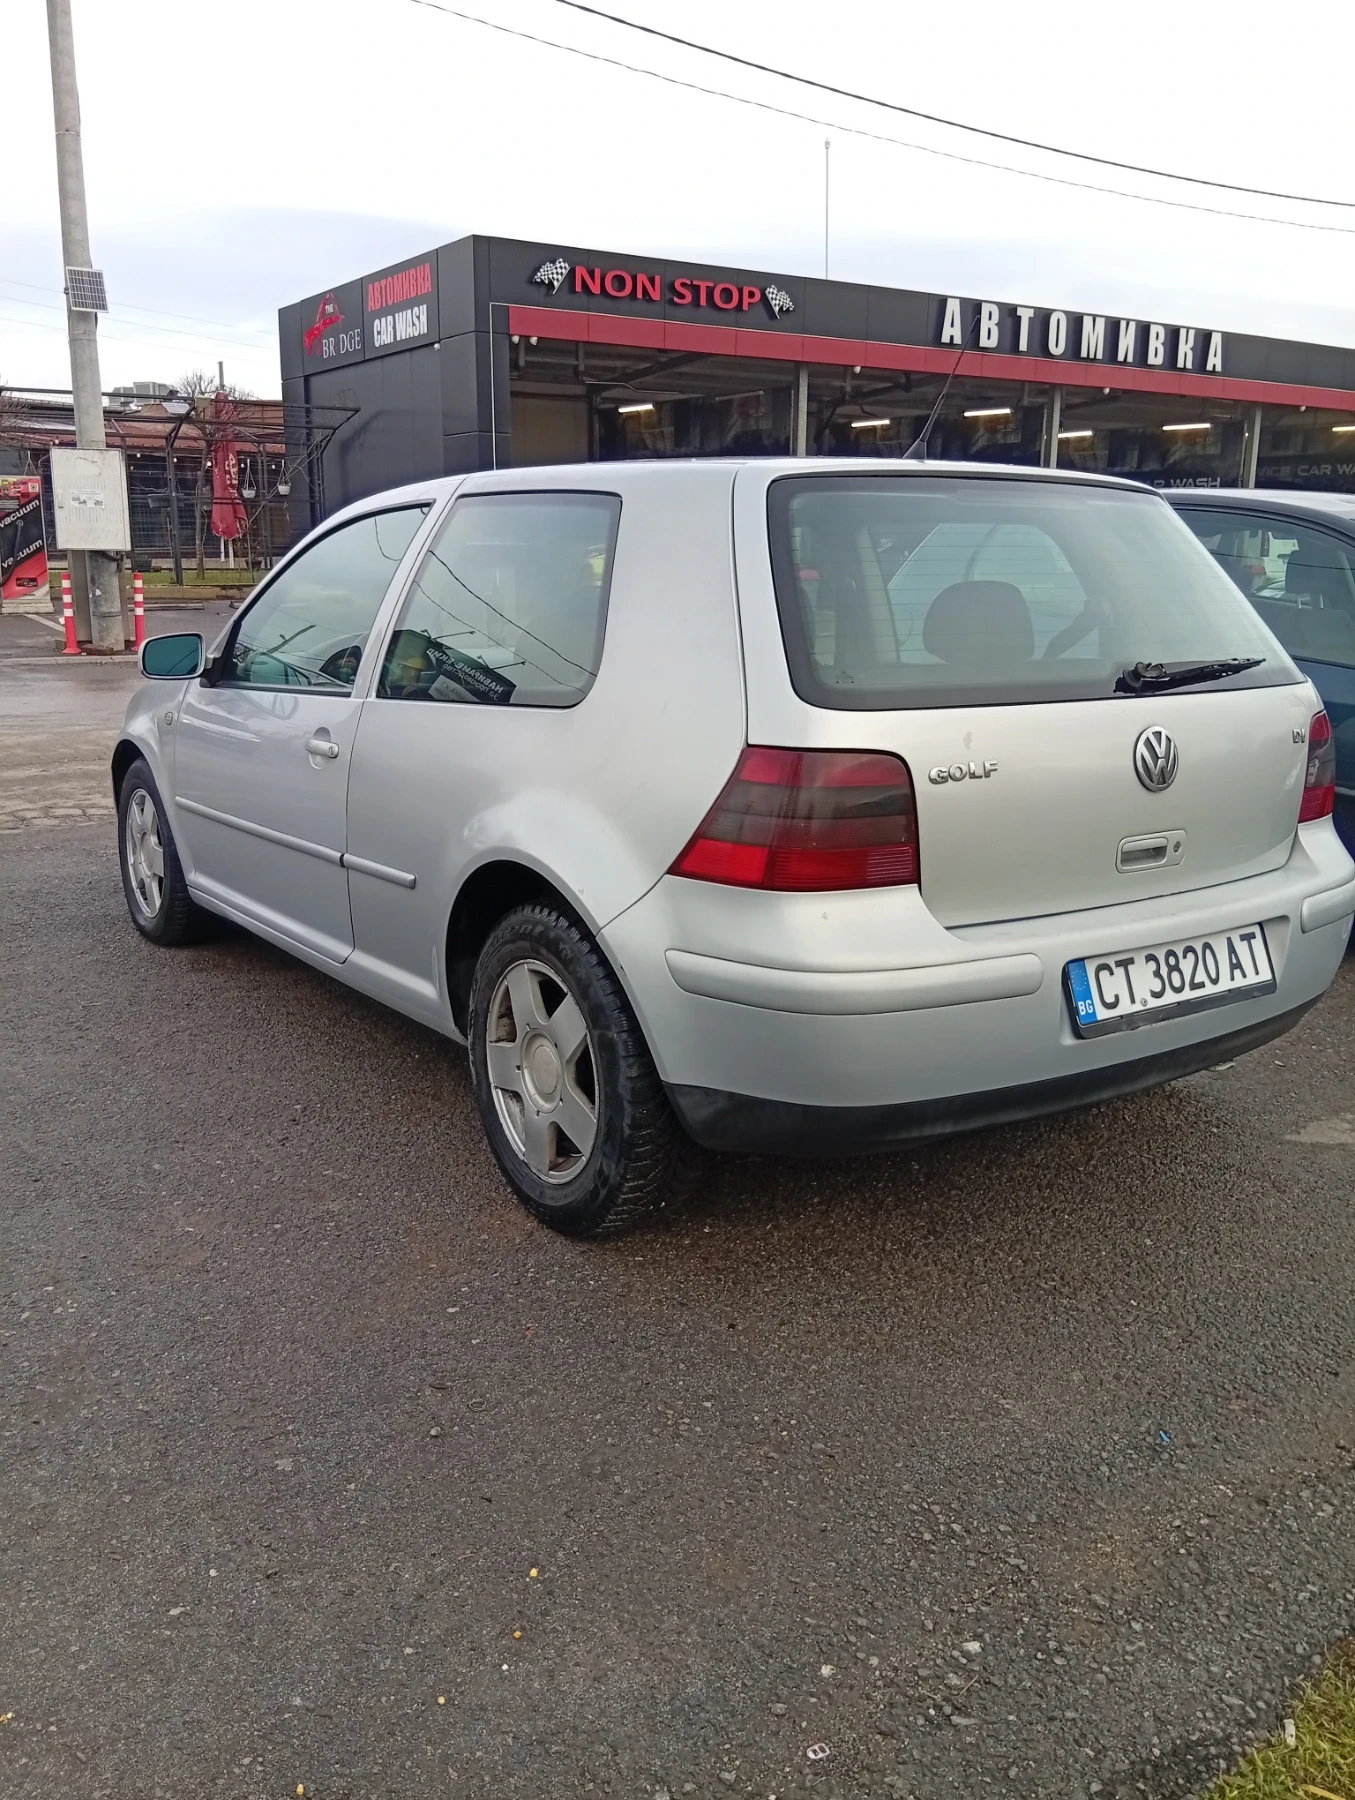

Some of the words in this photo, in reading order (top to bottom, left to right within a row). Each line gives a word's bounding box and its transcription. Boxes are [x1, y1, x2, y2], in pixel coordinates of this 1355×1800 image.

[368, 263, 432, 312] АВТОМИВКА
[575, 265, 661, 301] NON
[673, 277, 762, 312] STOP
[325, 303, 334, 314] THE
[374, 315, 395, 348] CAR
[395, 304, 428, 341] WASH
[941, 298, 1222, 373] АВТОМИВКА
[1170, 477, 1221, 488] WASH
[1297, 464, 1331, 476] CAR
[0, 499, 40, 529] vacuum
[928, 760, 998, 785] GOLF
[1095, 957, 1136, 1009] CT
[1144, 941, 1220, 999] 3820
[1226, 932, 1259, 981] AT
[1078, 1000, 1094, 1015] BG
